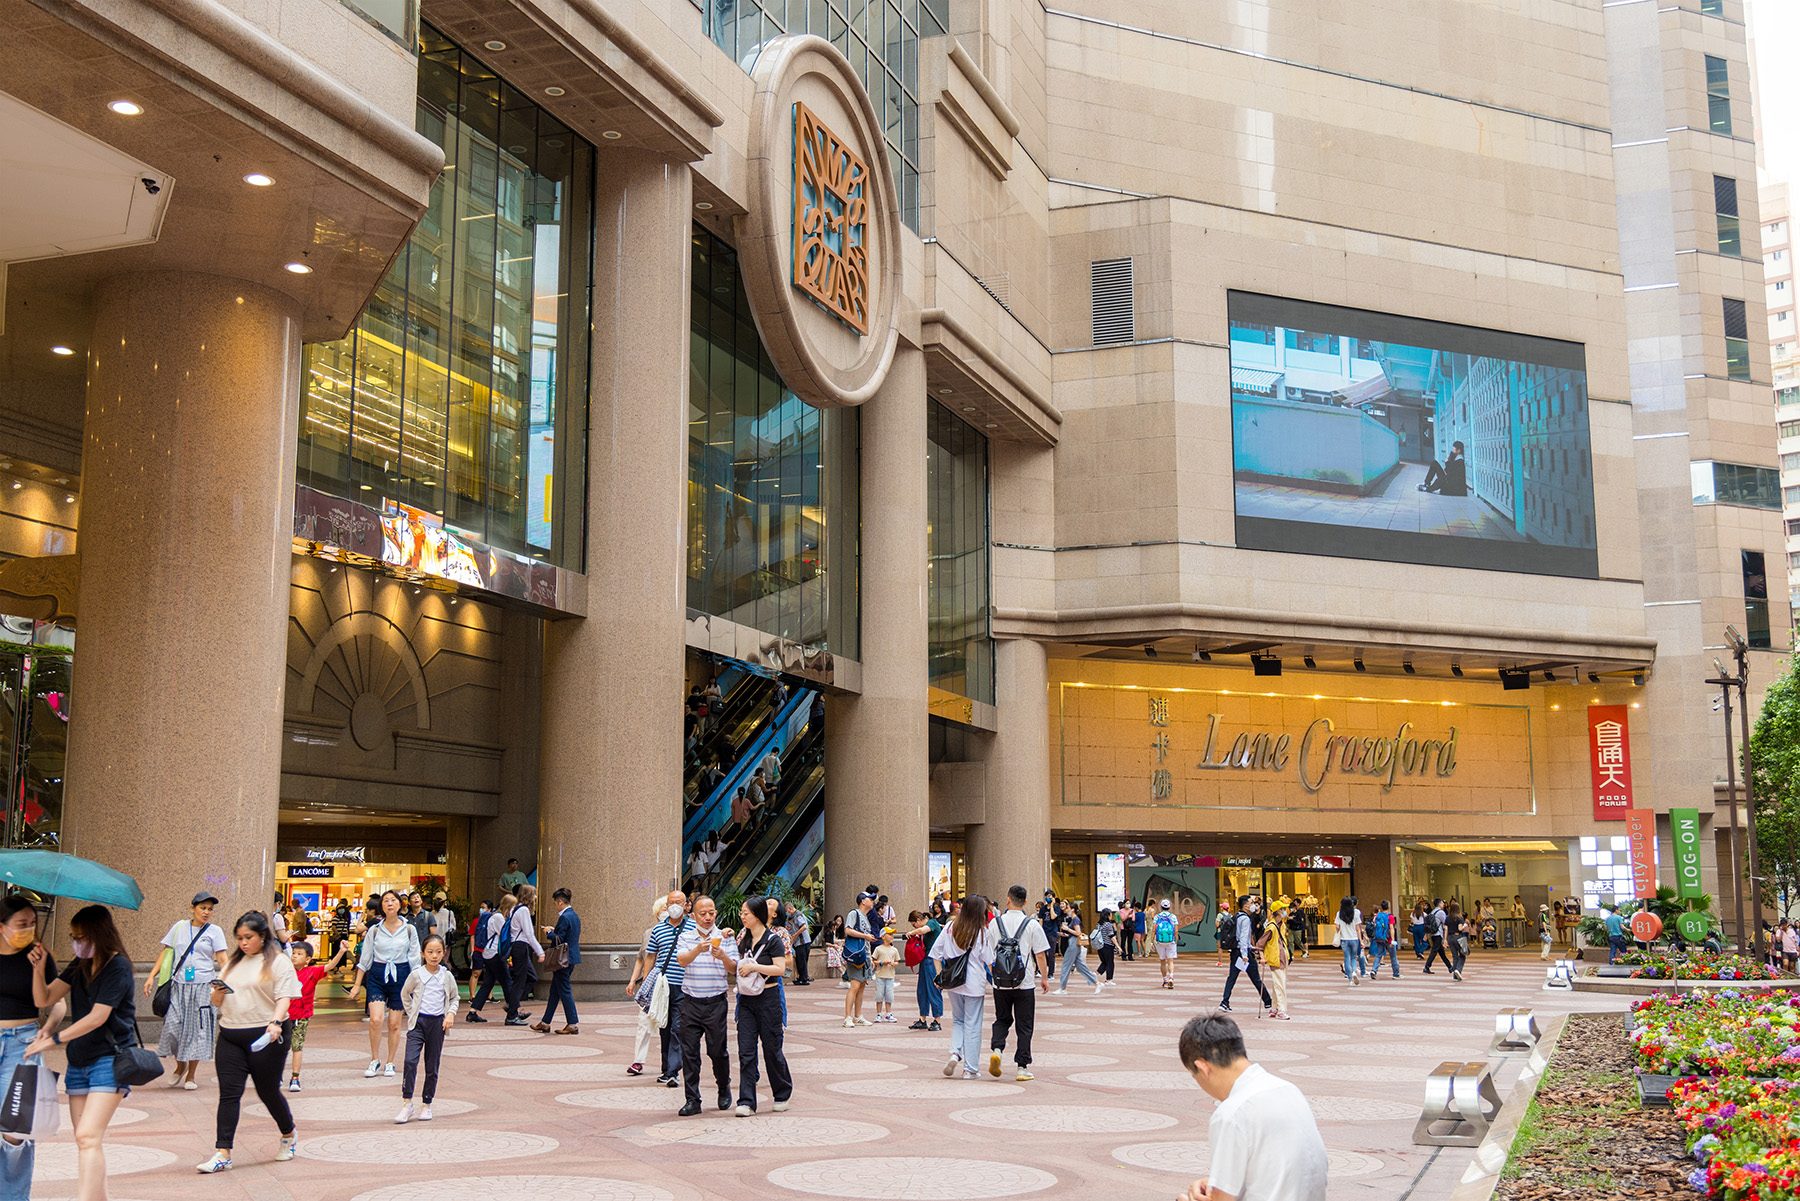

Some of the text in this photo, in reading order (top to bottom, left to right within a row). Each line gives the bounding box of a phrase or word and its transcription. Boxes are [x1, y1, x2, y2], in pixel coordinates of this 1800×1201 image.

[1150, 696, 1173, 800] 連卡佛
[1197, 713, 1460, 792] Lane Crawford
[1594, 720, 1626, 789] 食通天
[1680, 818, 1699, 889] LOG-ON
[1636, 920, 1652, 934] B1
[1686, 920, 1703, 934] B1
